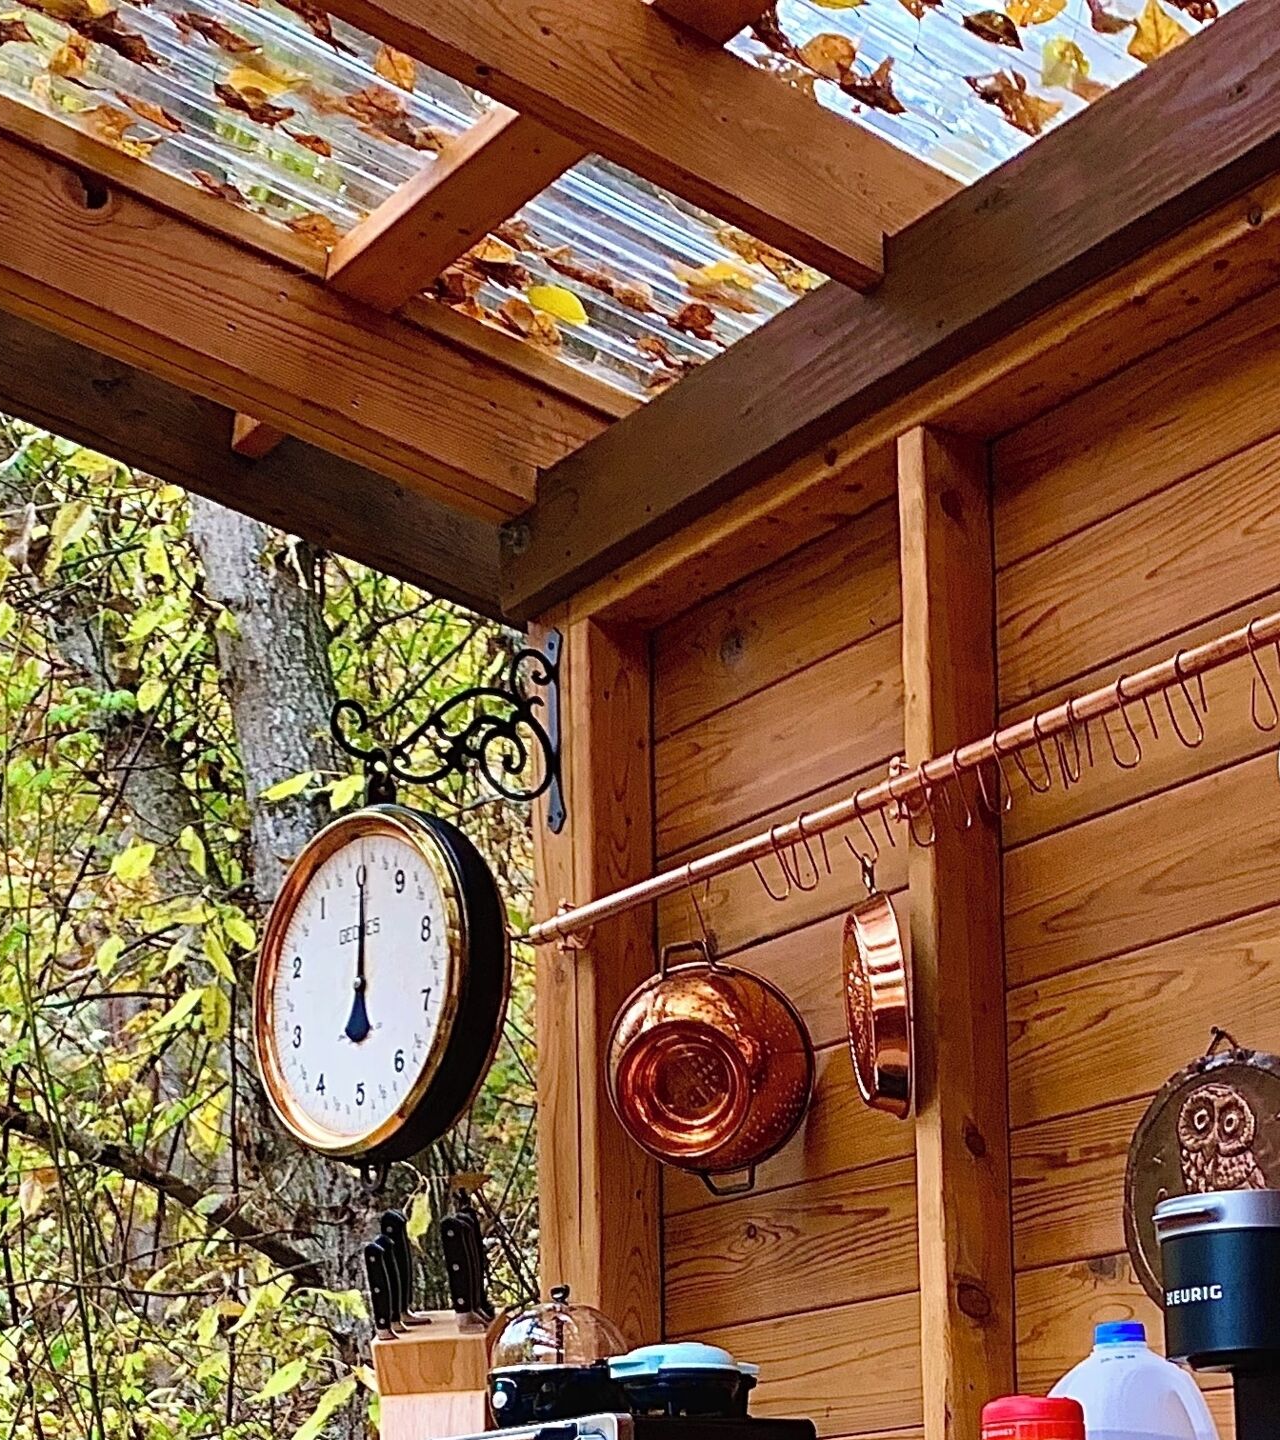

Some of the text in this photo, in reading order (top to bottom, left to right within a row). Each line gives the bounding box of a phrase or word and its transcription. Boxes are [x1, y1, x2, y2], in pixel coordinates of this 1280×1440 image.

[394, 869, 405, 894] 9
[320, 896, 326, 920] 1
[420, 915, 431, 942] 8
[293, 956, 302, 979] 2
[421, 987, 432, 1011] 7
[292, 1025, 302, 1048] 3
[394, 1049, 405, 1073] 6
[316, 1073, 326, 1096] 4
[355, 1082, 365, 1106] 5
[1166, 1284, 1223, 1307] KEURIG
